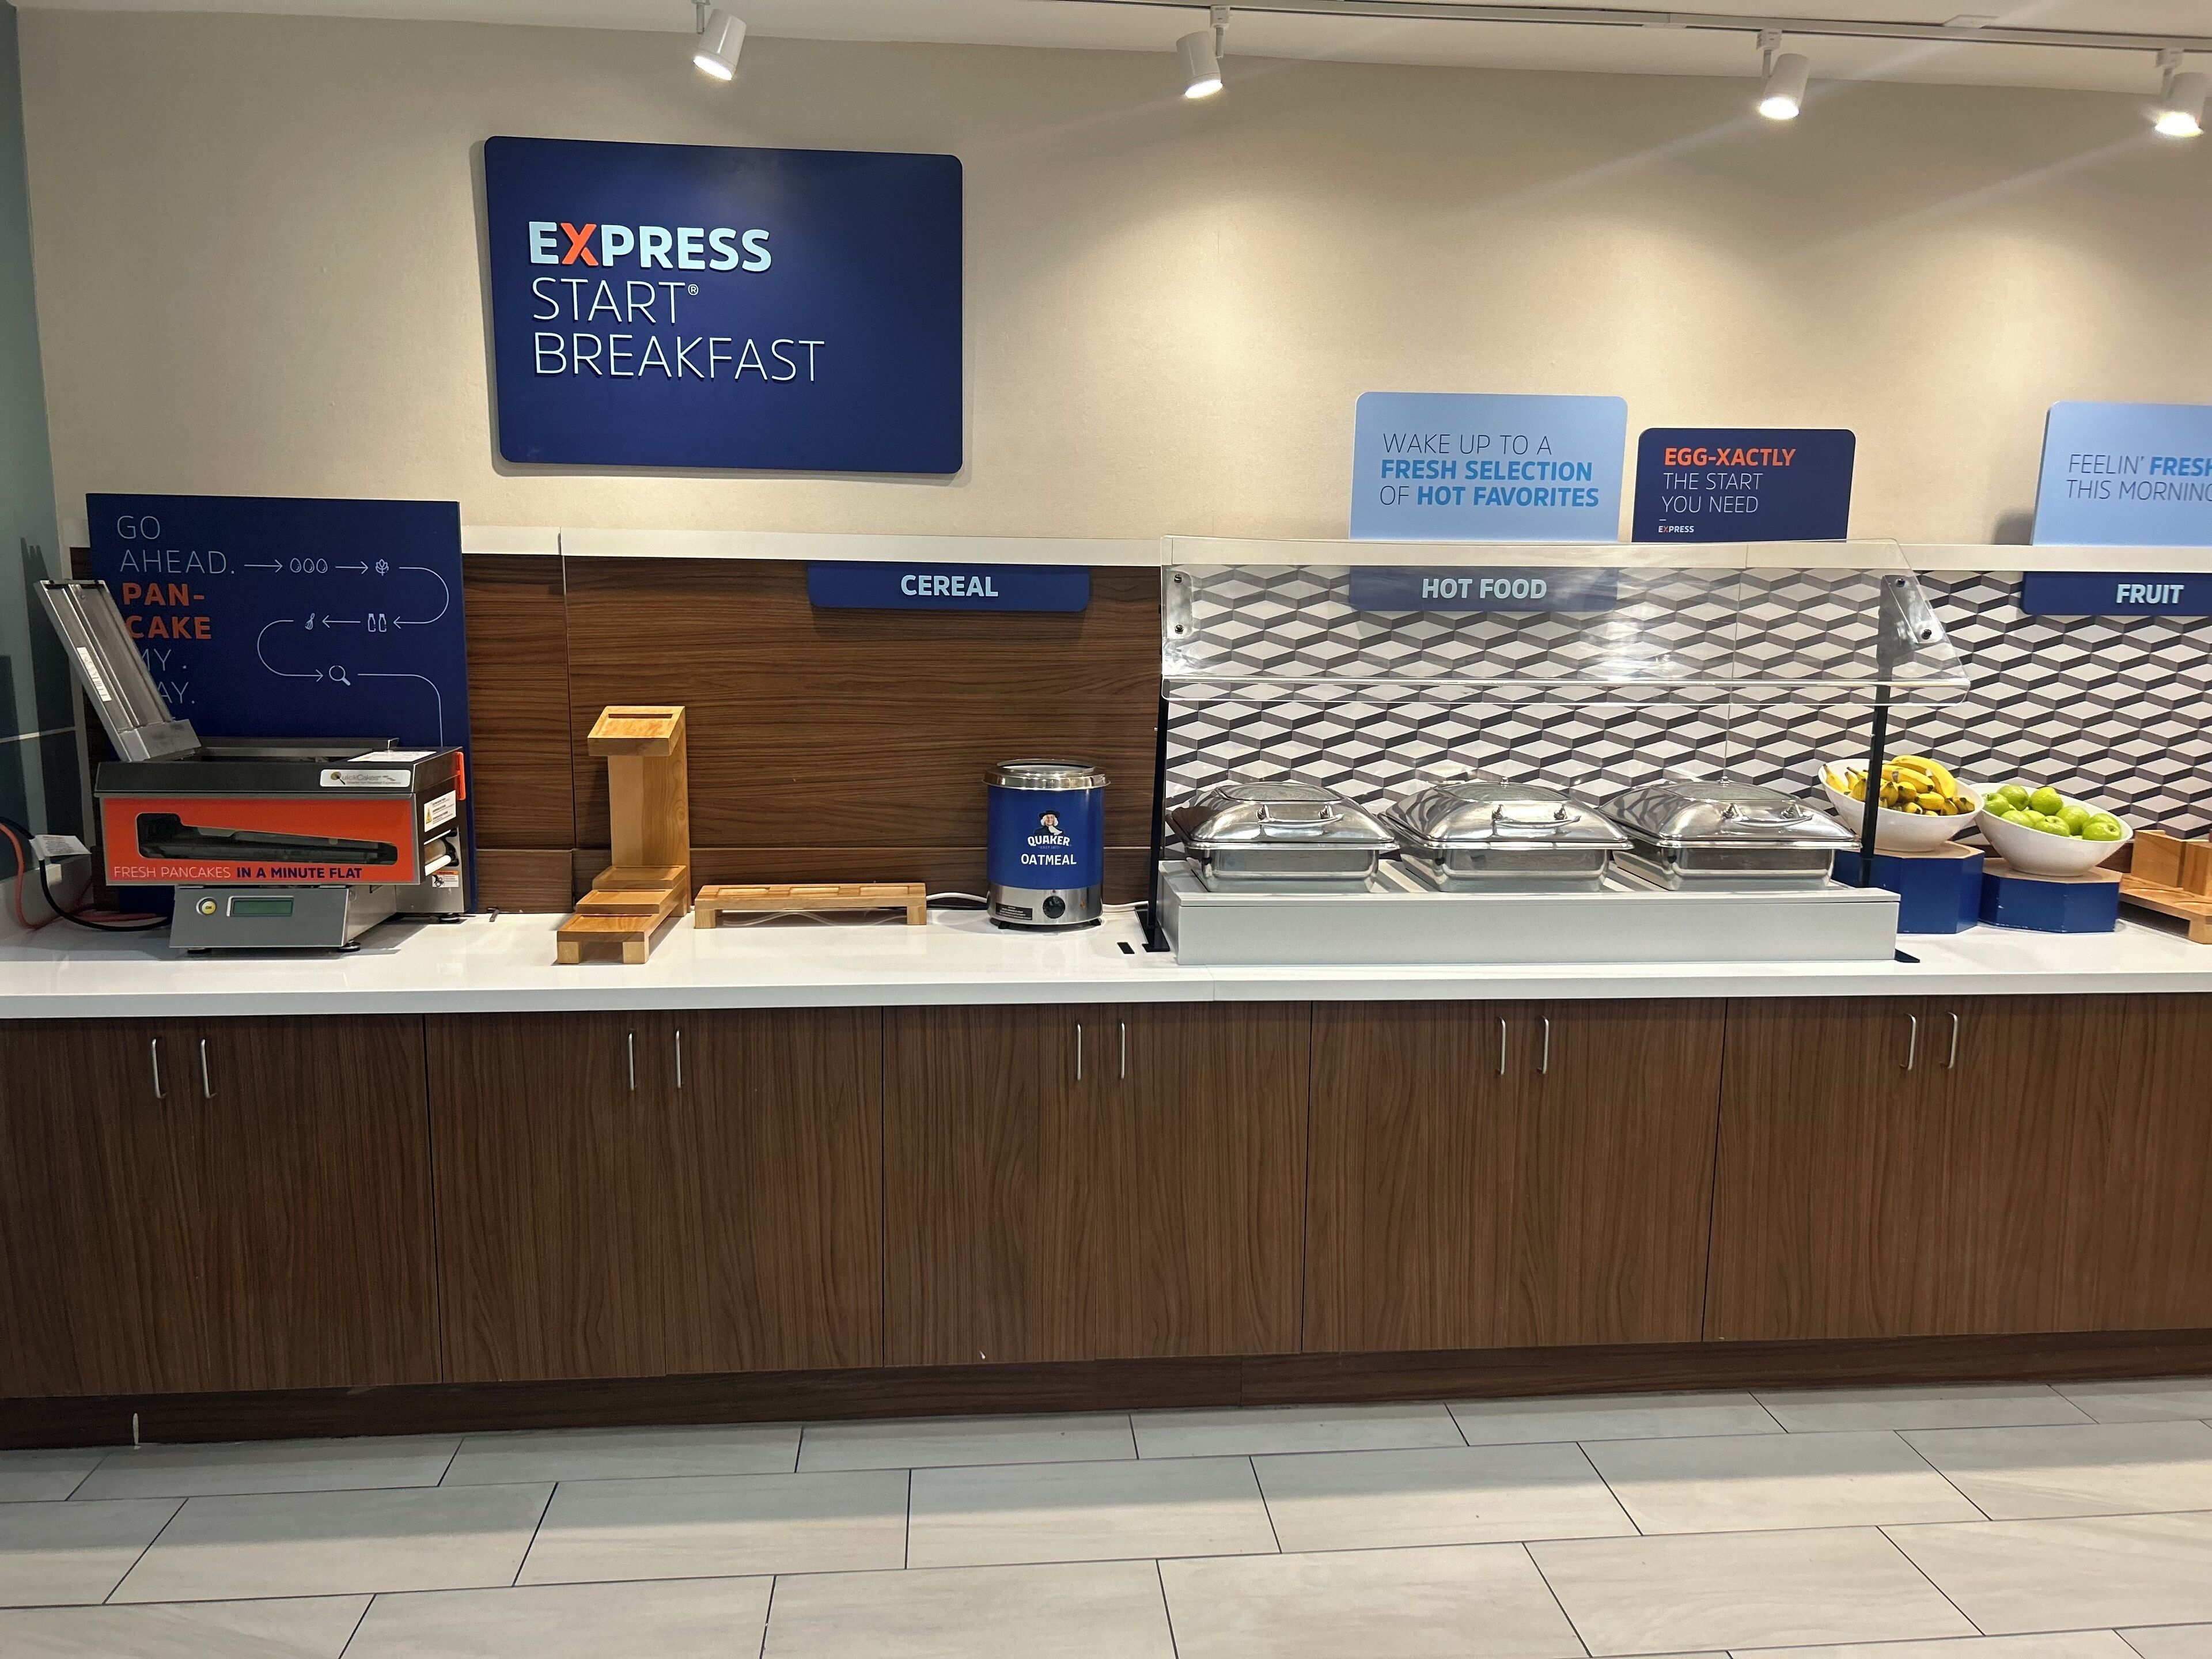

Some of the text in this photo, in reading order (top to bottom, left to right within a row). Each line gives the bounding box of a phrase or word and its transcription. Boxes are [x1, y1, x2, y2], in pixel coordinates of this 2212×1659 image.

[528, 221, 772, 272] EXPRESS
[534, 331, 825, 381] BREAKFAST
[1383, 433, 1552, 455] WAKE UP TO A
[1664, 447, 1796, 466] EGG-XACTLY
[1381, 459, 1592, 482] FRESH SELECTION
[1663, 472, 1763, 490] THE START
[1380, 485, 1599, 507] OF HOT FAVORITES
[2066, 479, 2112, 499] THIS
[1661, 495, 1758, 513] YOU NEED
[117, 515, 160, 539] GO
[120, 549, 234, 574] AHEAD.
[122, 582, 204, 606] PAN-
[900, 574, 999, 597] CEREAL
[1422, 578, 1547, 599] HOT FOOD
[2116, 584, 2185, 604] FRUIT
[125, 615, 212, 639] CAKE
[1027, 835, 1070, 847] QUAKER
[1021, 853, 1077, 865] OATMEAL
[114, 866, 362, 878] FRESH PANCAKES IN A MINUTE FLAT
